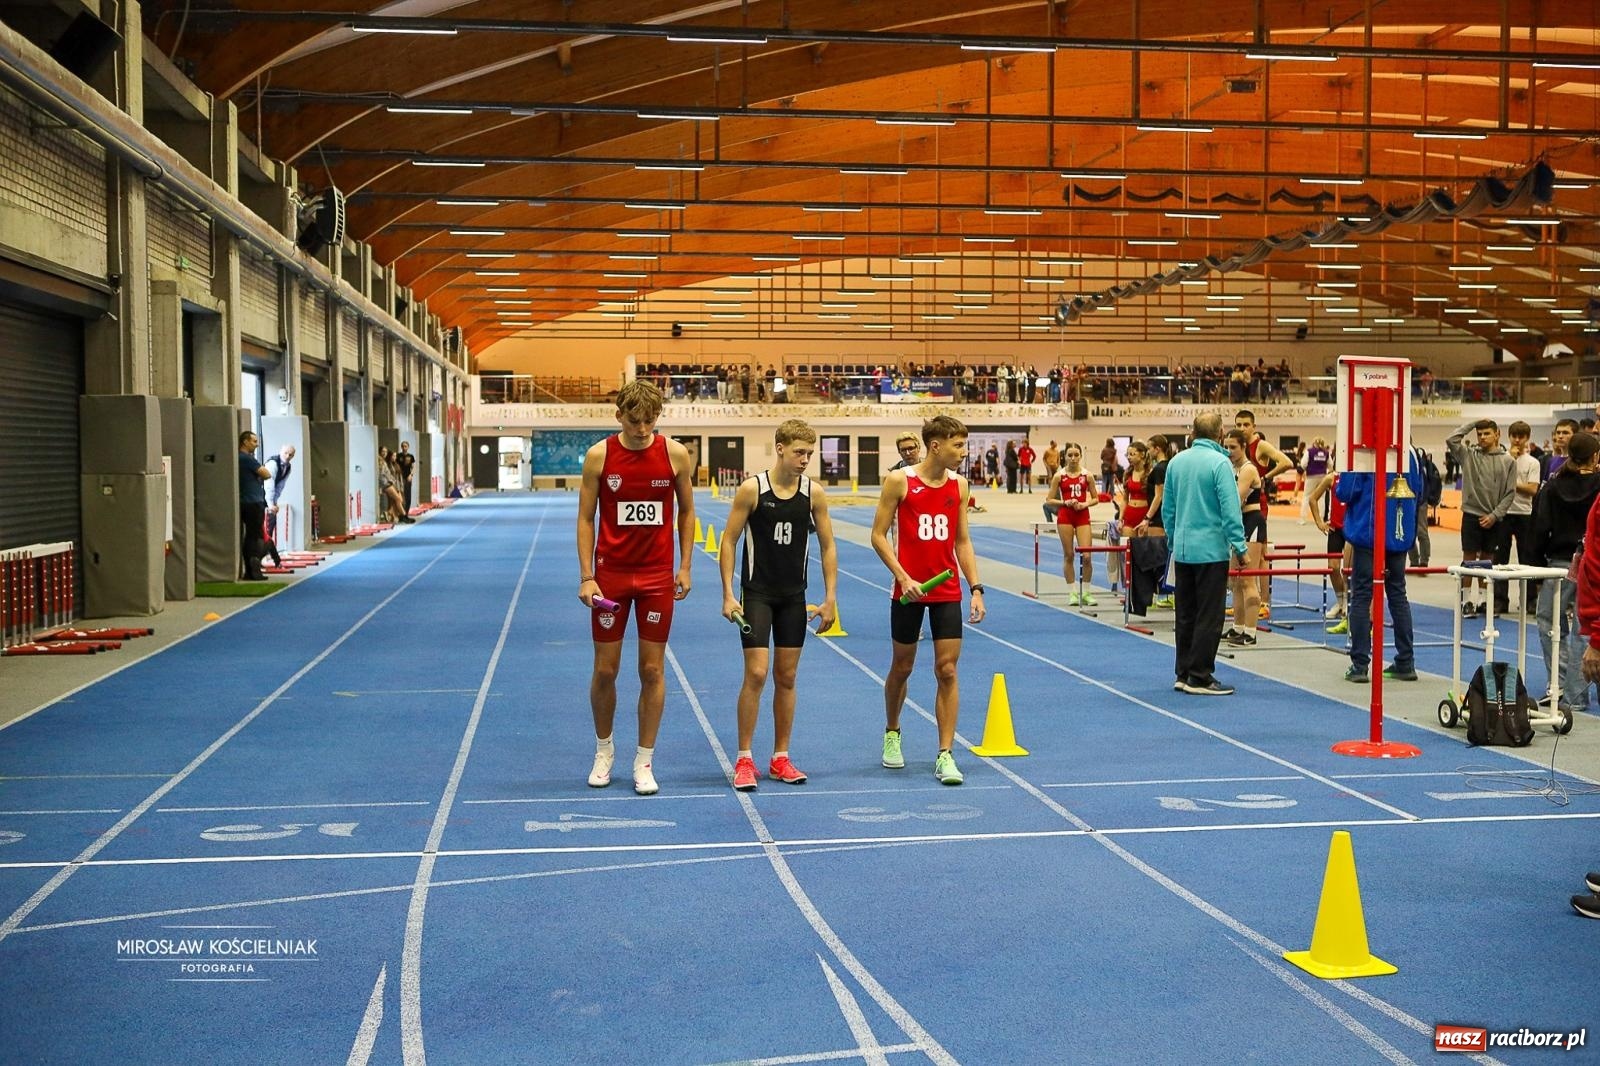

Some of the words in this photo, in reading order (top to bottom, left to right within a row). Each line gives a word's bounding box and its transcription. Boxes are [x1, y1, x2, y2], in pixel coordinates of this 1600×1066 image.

[625, 503, 656, 522] 269
[773, 521, 793, 545] 43
[918, 513, 949, 541] 88
